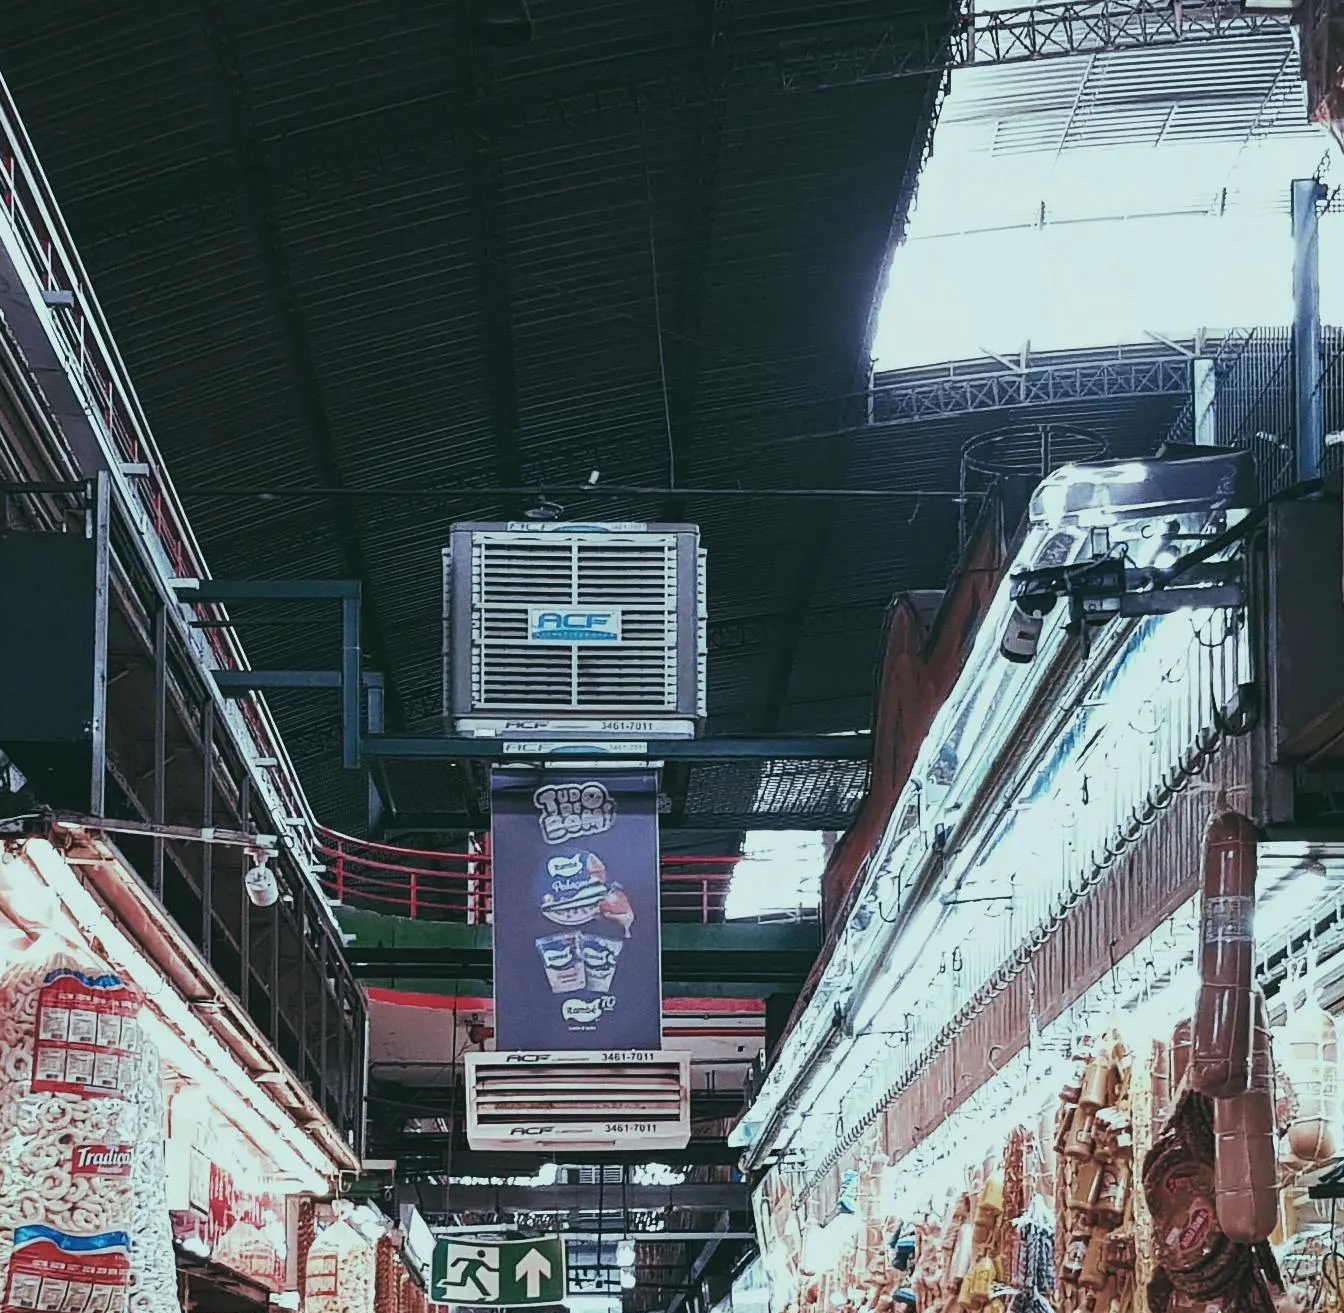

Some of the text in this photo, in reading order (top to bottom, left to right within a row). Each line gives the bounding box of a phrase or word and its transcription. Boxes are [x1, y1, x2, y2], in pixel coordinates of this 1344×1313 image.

[537, 612, 612, 629] ACF
[506, 1052, 654, 1063] ACF 3461-7011
[510, 1123, 657, 1135] ACF 3461-7011
